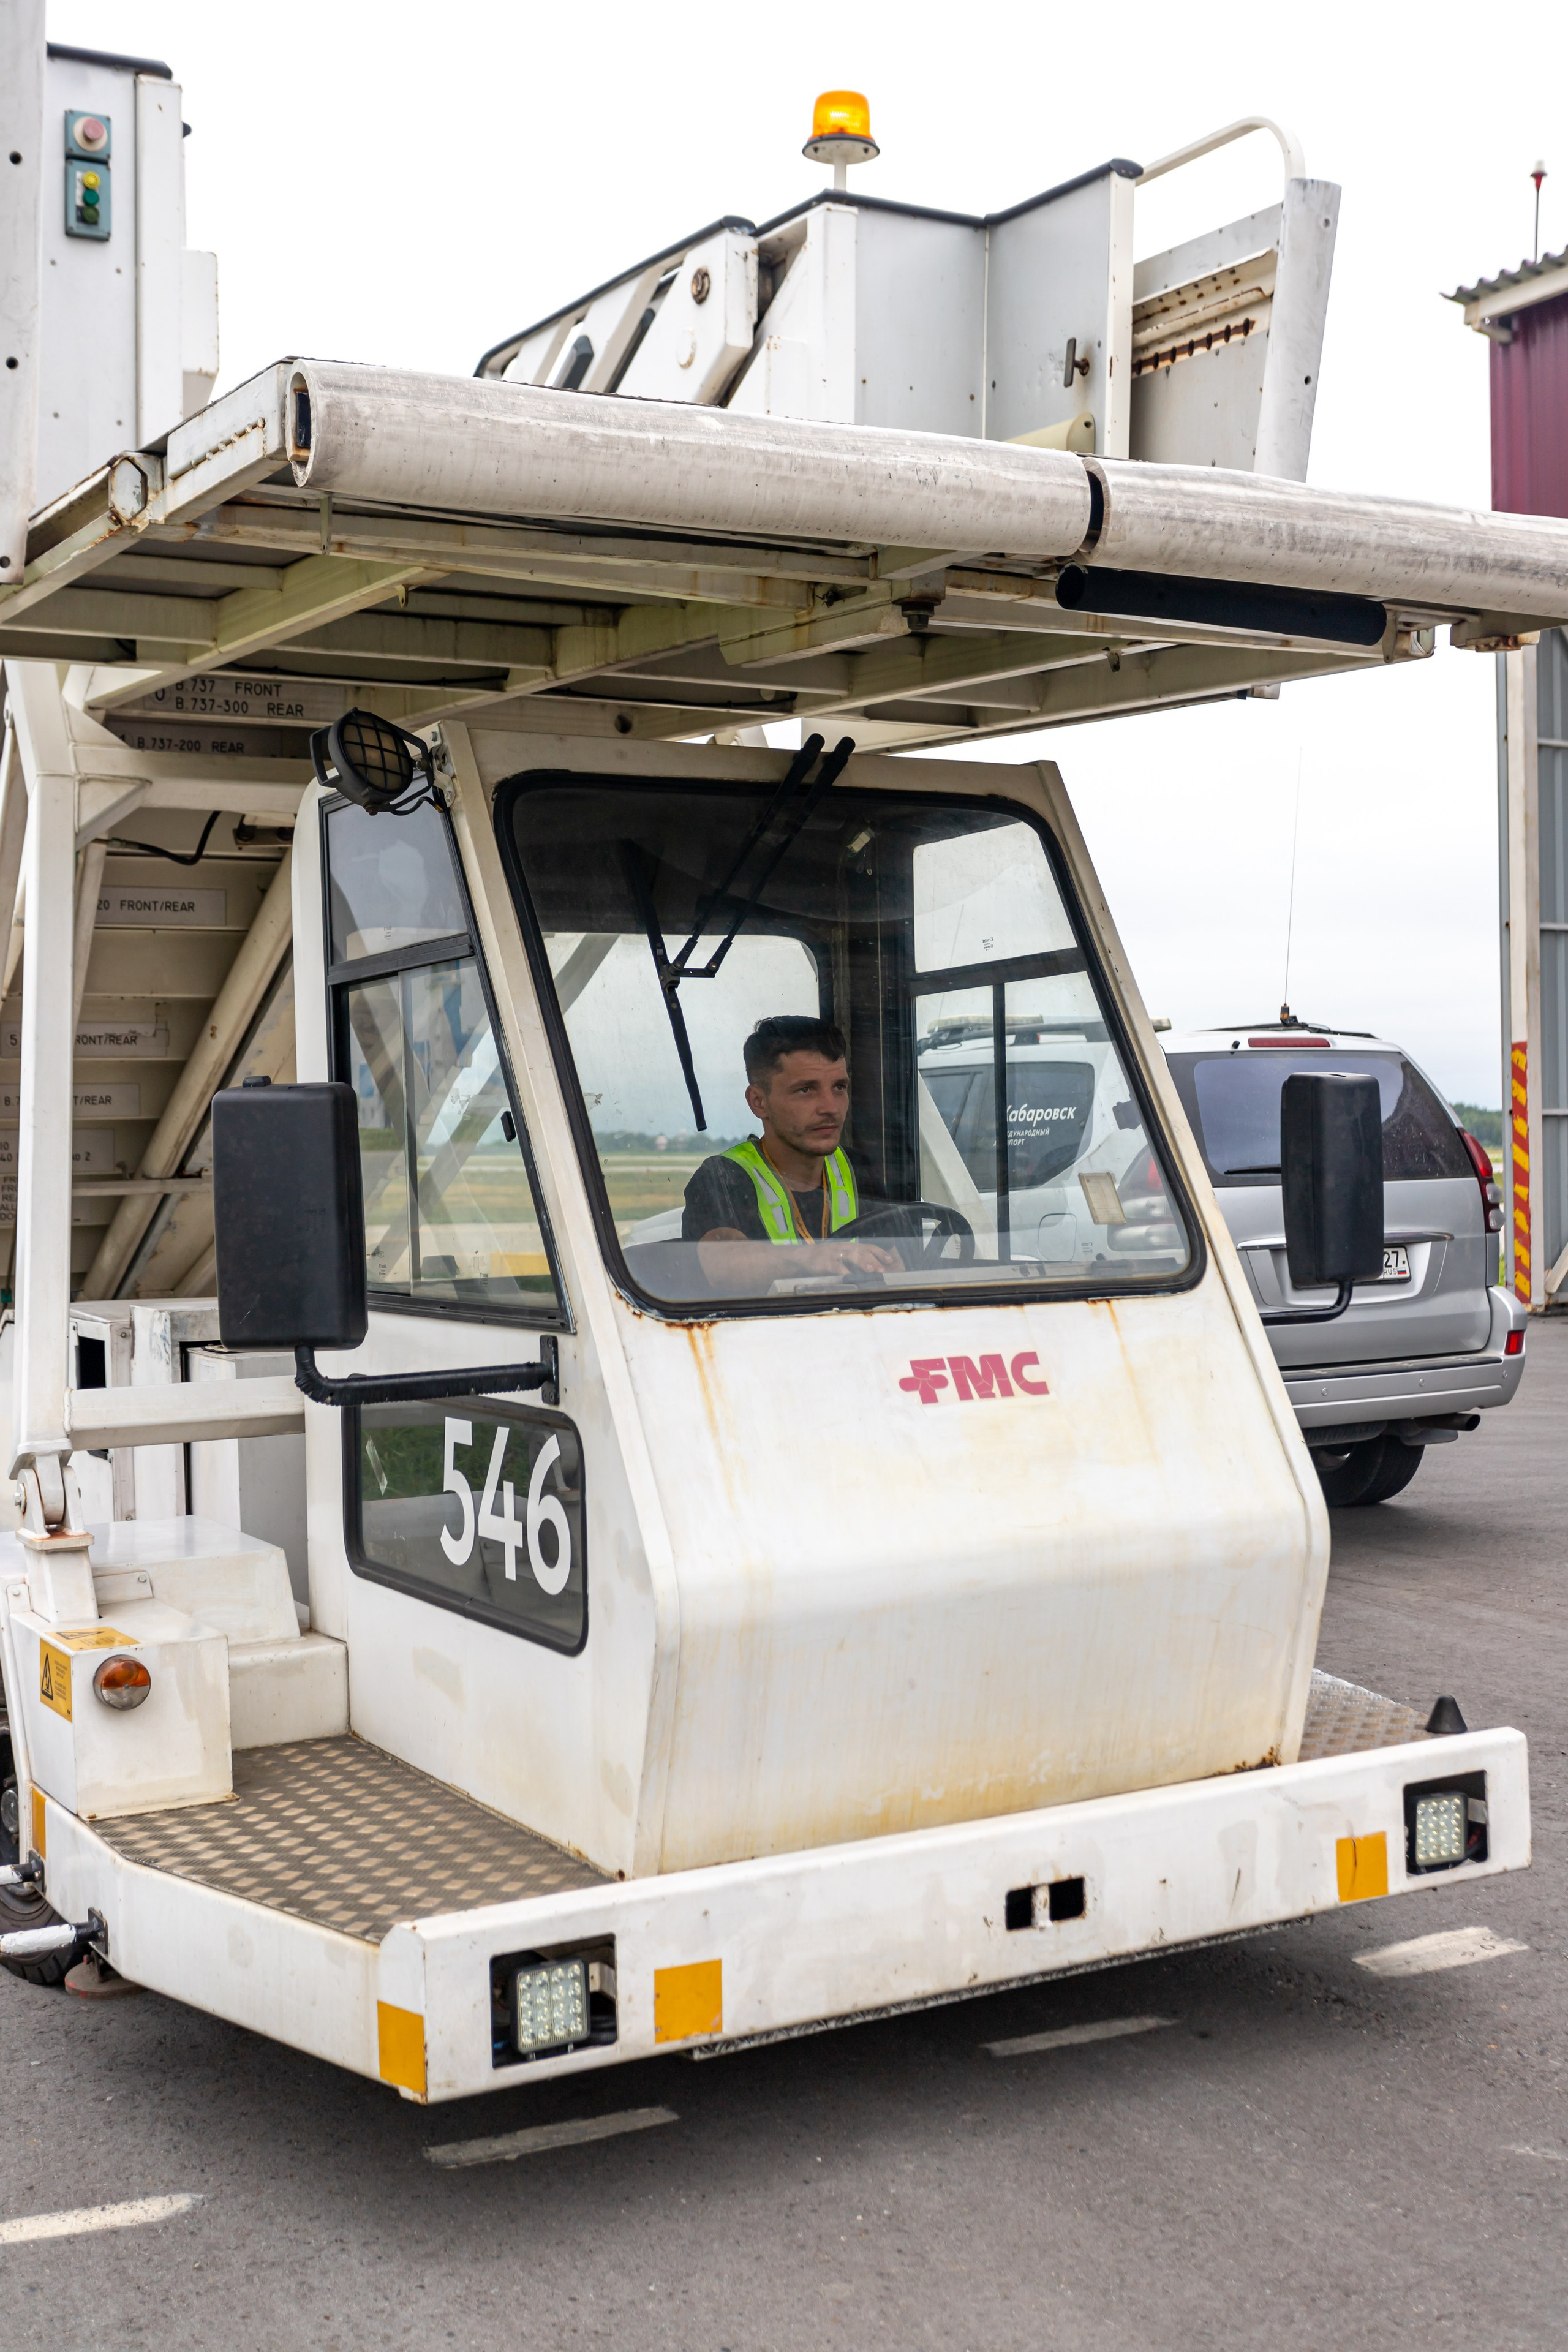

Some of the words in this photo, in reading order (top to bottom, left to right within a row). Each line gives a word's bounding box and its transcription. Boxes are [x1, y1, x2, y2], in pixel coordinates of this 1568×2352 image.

[235, 682, 282, 697] FRONT
[175, 697, 249, 714] B.737-300
[267, 703, 304, 717] REAR
[137, 736, 202, 752] B.737-200
[211, 741, 245, 754] REAR
[119, 900, 195, 912] FRONT/REAR
[9, 1034, 18, 1046] 5
[75, 1035, 138, 1046] RONT/REAR
[899, 1352, 1050, 1404] FMC
[440, 1417, 571, 1595] 546
